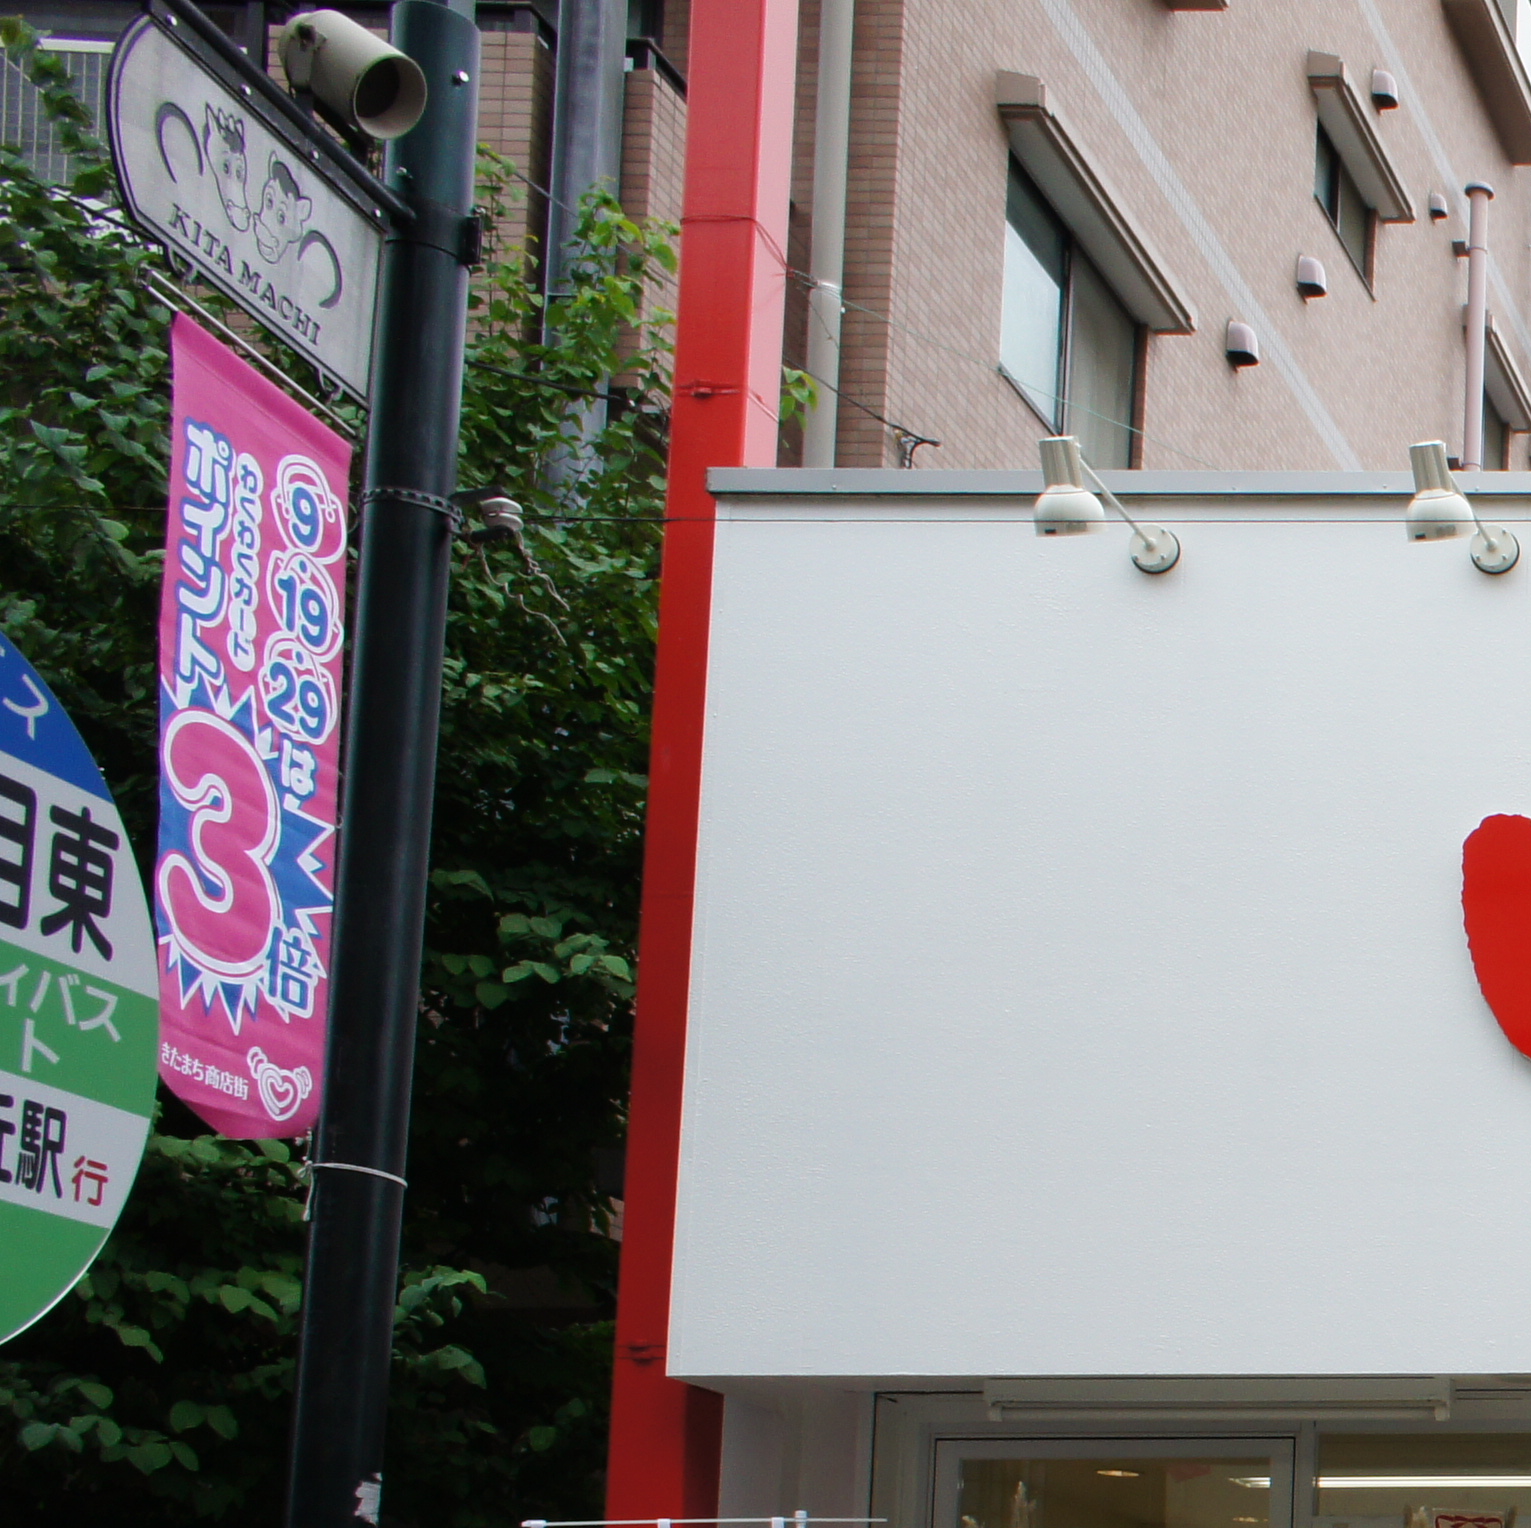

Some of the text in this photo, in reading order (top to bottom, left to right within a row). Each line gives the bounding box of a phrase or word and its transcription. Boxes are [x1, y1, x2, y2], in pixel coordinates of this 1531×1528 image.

[170, 203, 322, 346] KITA MACHI
[178, 421, 232, 680] ポイント
[161, 1041, 249, 1100] きたまち商店街
